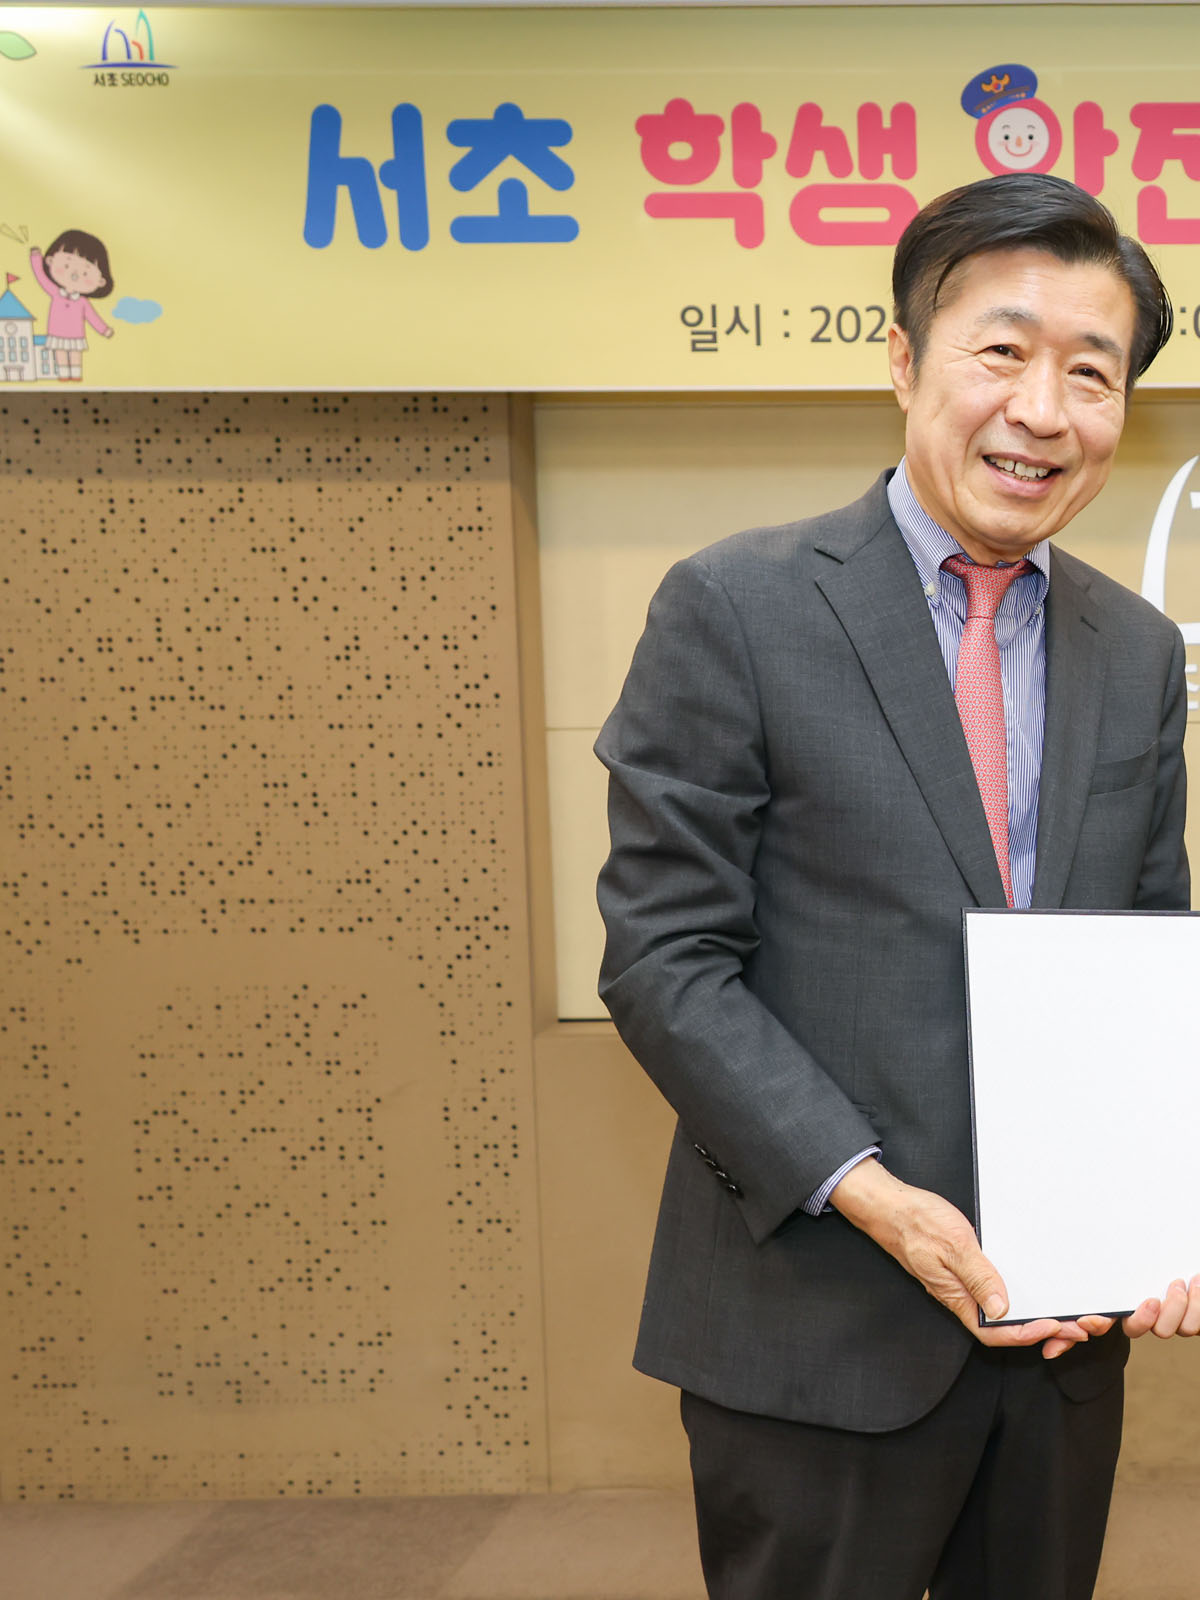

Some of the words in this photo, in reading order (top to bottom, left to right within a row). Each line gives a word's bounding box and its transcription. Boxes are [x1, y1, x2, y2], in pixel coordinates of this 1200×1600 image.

[93, 72, 118, 87] 서초
[121, 72, 170, 87] SEOCHO
[303, 102, 580, 252] 서초
[634, 97, 919, 249] 학생
[680, 303, 764, 352] 일시
[811, 305, 887, 343] 202
